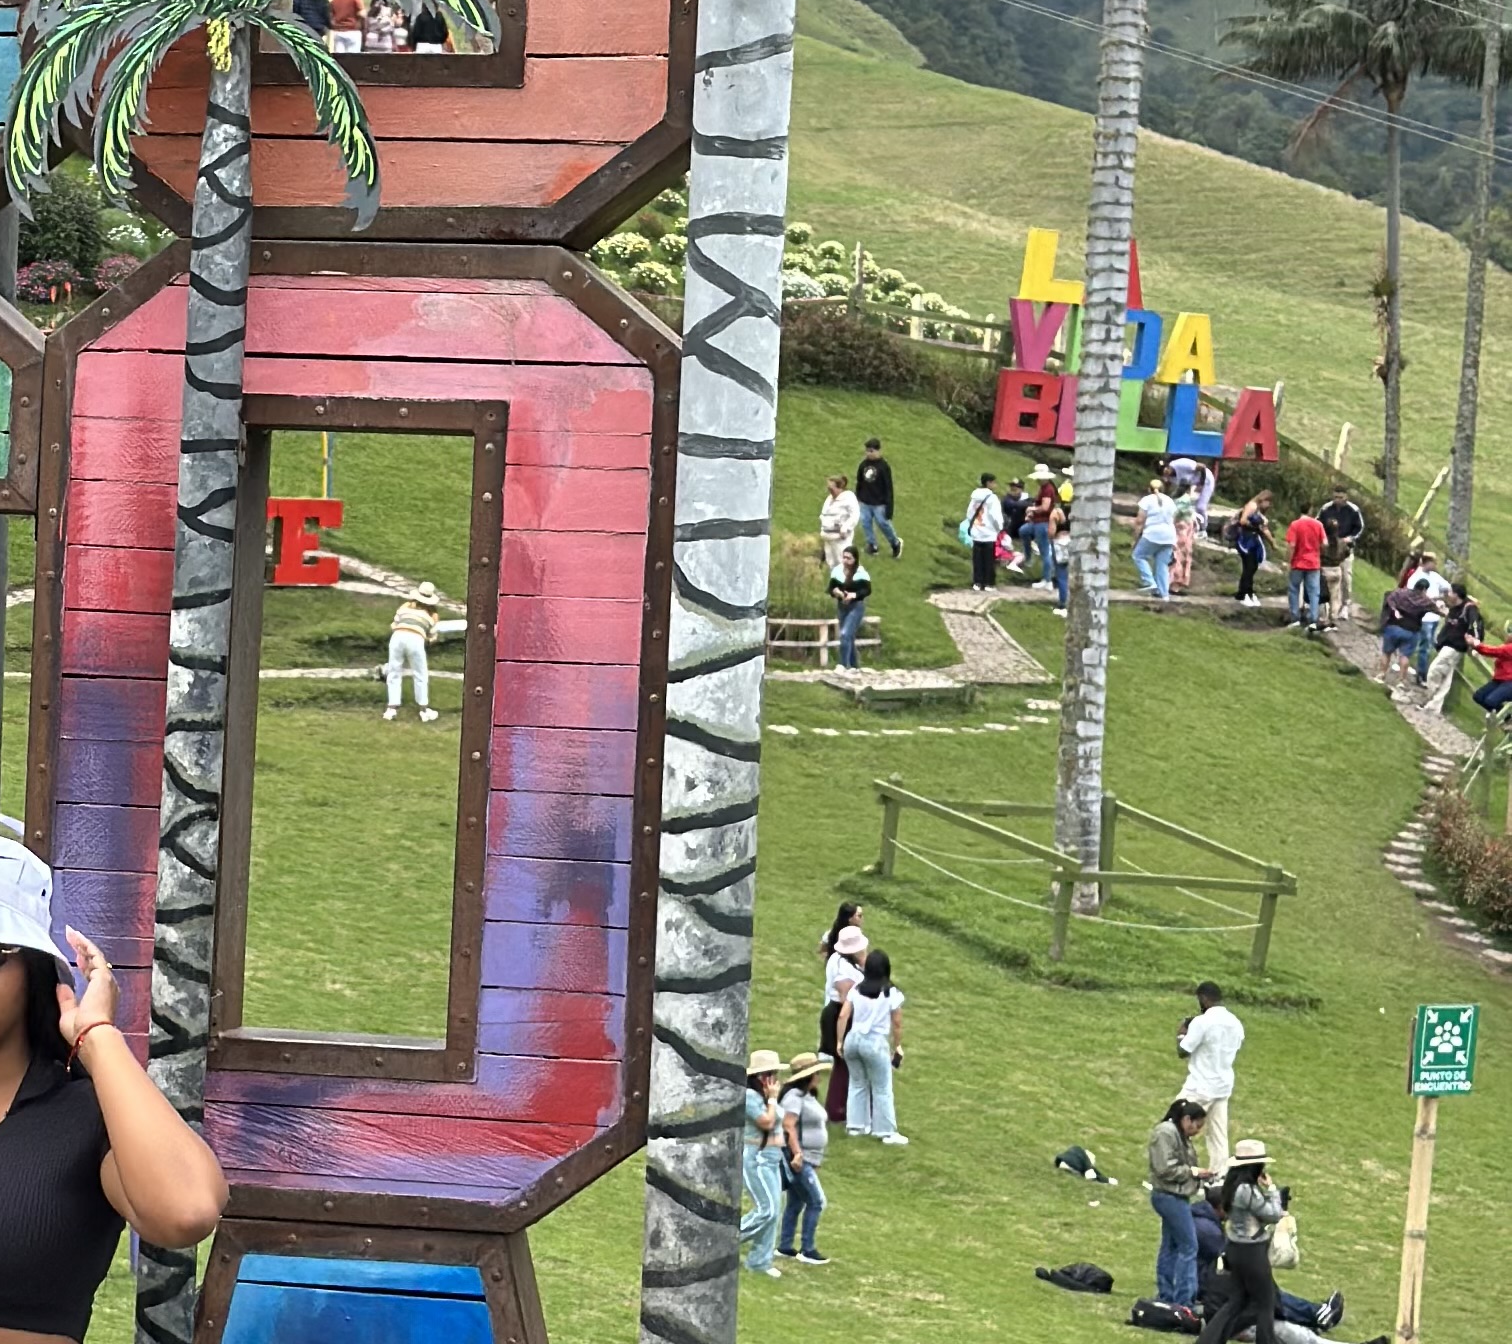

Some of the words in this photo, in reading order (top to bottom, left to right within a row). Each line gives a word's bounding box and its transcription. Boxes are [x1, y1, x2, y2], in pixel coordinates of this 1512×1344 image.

[1419, 1071, 1453, 1081] PUNTO
[1453, 1070, 1467, 1081] DE
[1414, 1080, 1472, 1092] ENCUENTRO
